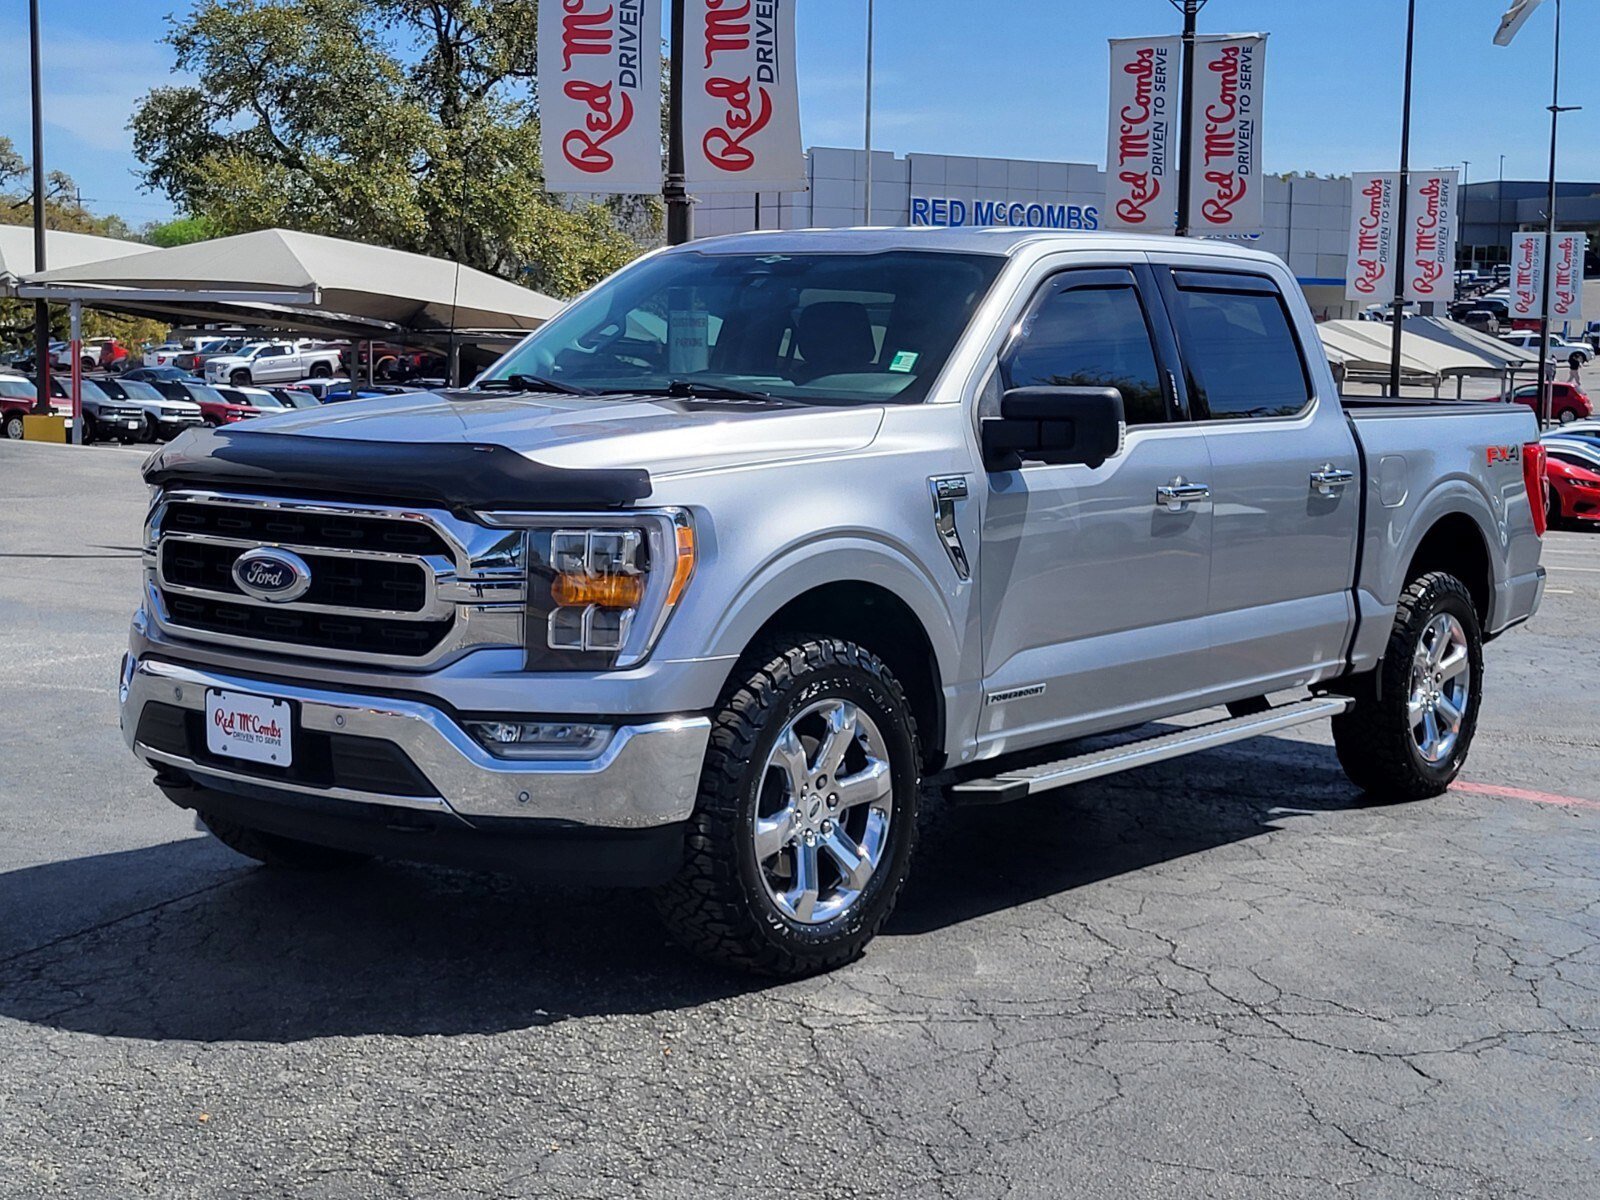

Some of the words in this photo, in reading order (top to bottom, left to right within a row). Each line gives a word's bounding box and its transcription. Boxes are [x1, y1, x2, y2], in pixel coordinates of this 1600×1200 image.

[755, 0, 774, 84] DRIVE
[1154, 48, 1168, 92] SERVE
[1240, 46, 1253, 90] SERVE
[1119, 48, 1154, 167] McCombs
[1153, 97, 1165, 116] TO
[1204, 46, 1240, 167] McCombs
[1239, 95, 1251, 115] TO
[562, 80, 634, 173] Red
[702, 76, 773, 172] Red
[1152, 121, 1165, 176] DRIVEN
[1238, 120, 1250, 175] DRIVEN
[1116, 171, 1160, 223] Red
[1202, 171, 1247, 224] Red
[1382, 179, 1392, 208] SERVE
[1440, 178, 1449, 208] SERVE
[910, 196, 966, 227] RED
[1358, 179, 1382, 256] McCombs
[1381, 210, 1389, 224] TO
[1416, 178, 1440, 256] McCombs
[1439, 210, 1447, 224] TO
[1379, 227, 1389, 263] DRIVEN
[1437, 227, 1446, 263] DRIVEN
[1517, 237, 1534, 288] McCombs
[1556, 237, 1572, 288] McCombs
[1355, 259, 1385, 293] Red
[1412, 259, 1443, 293] Red
[1515, 291, 1535, 313] Red
[1554, 291, 1574, 313] Red
[1486, 445, 1519, 466] FX4
[247, 561, 283, 586] Ford
[990, 686, 1045, 703] POWERBOOST
[214, 708, 235, 735] Red
[237, 713, 281, 738] McCombs
[233, 731, 254, 741] DRIVEN
[255, 735, 264, 743] TO
[264, 737, 281, 747] SERVE
